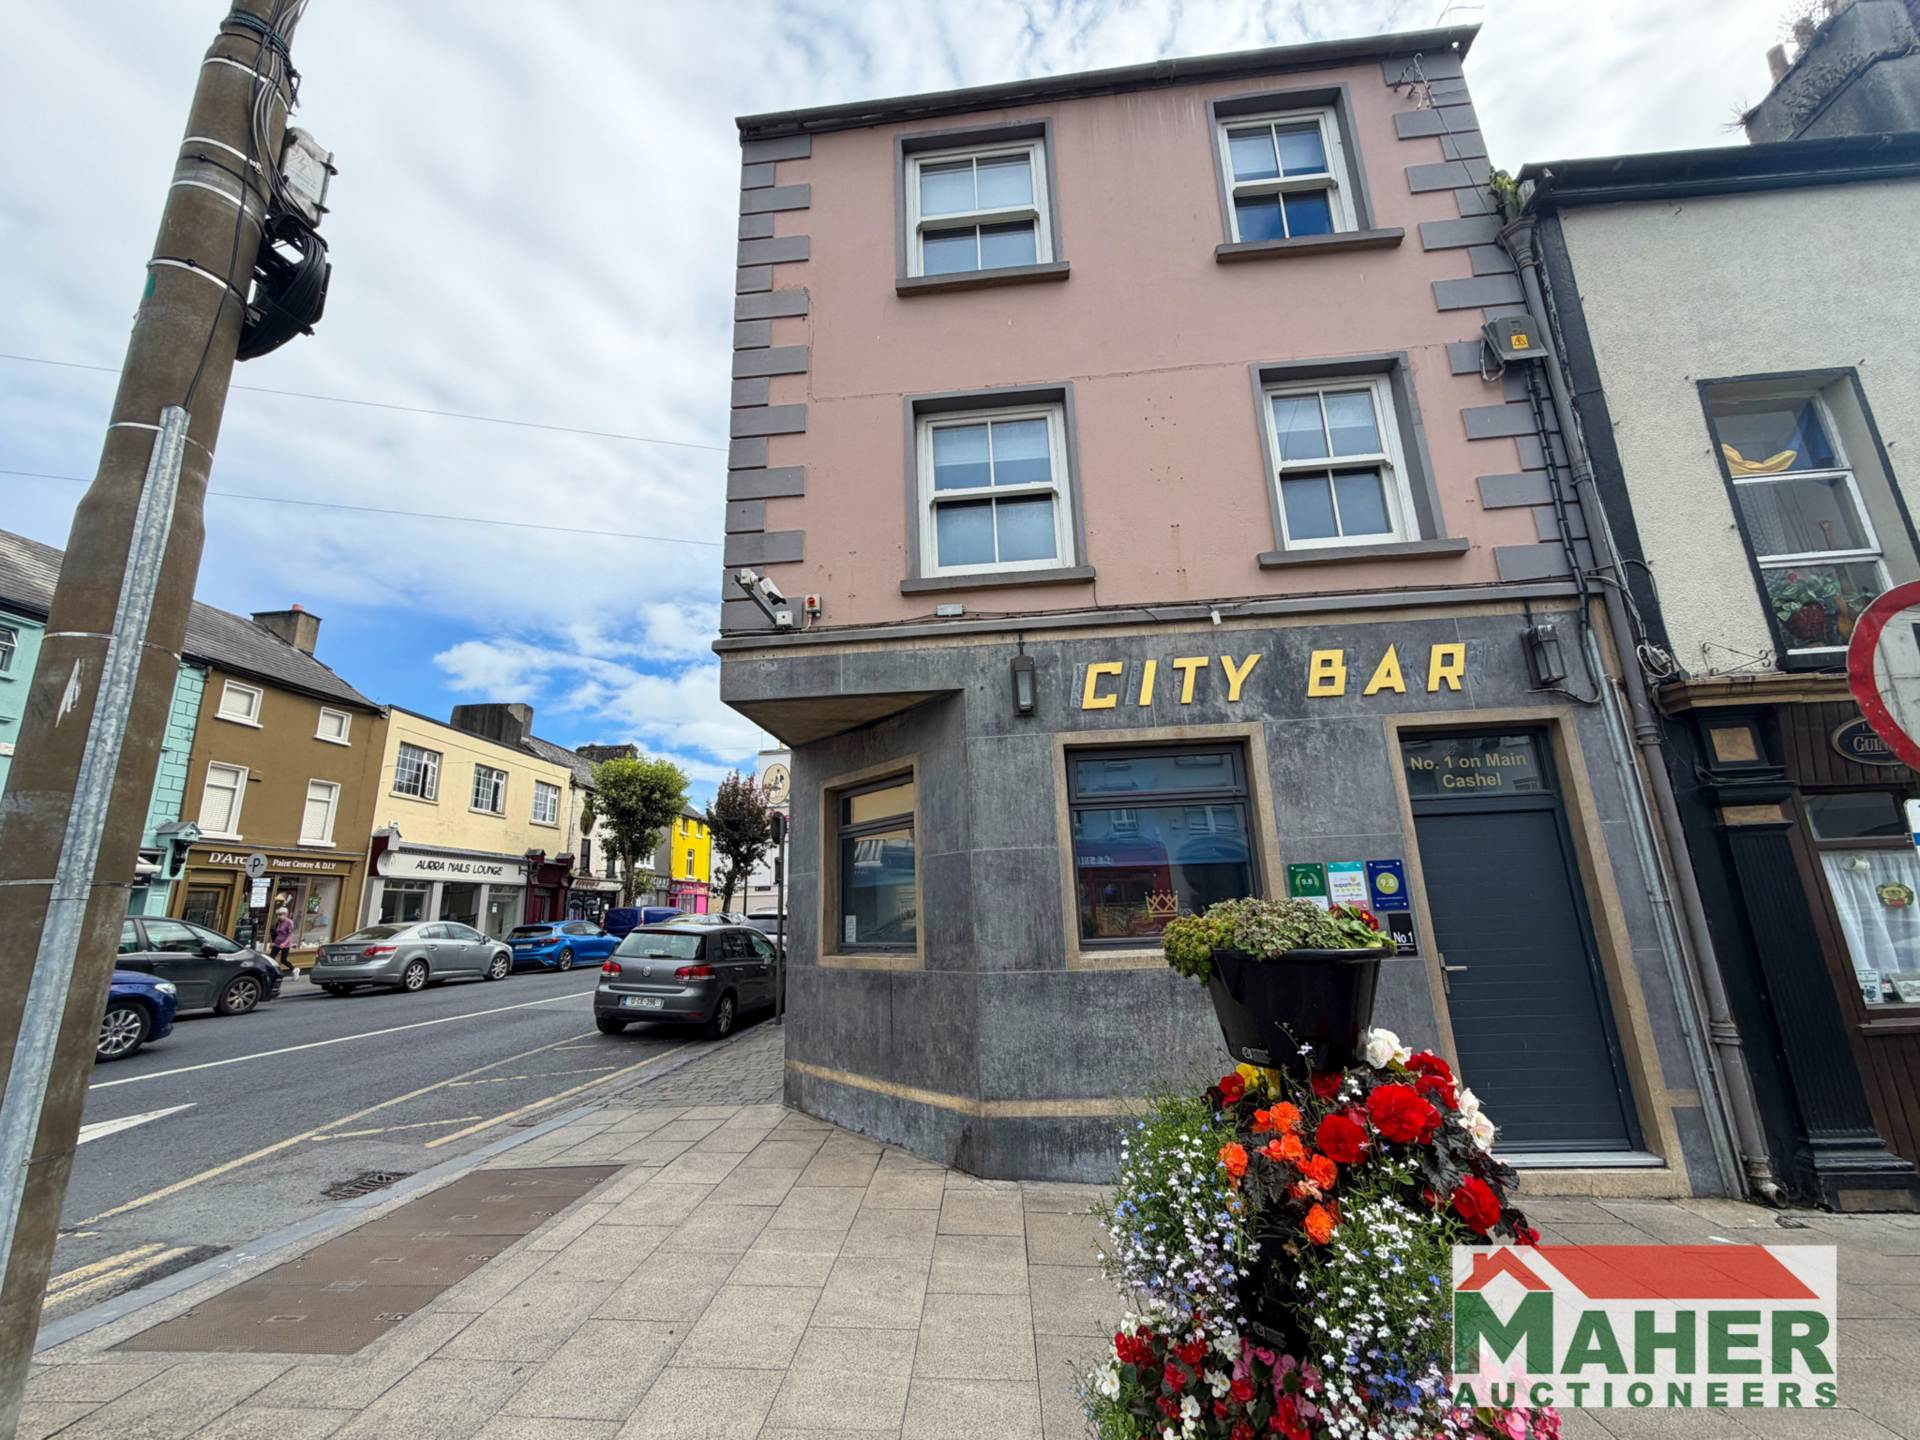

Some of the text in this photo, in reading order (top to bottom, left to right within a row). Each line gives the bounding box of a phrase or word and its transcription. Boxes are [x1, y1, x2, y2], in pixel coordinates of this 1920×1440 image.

[1082, 642, 1466, 710] CITY BAR
[1410, 752, 1527, 770] No. 1 on Main
[1442, 772, 1503, 788] Cashel
[272, 858, 291, 868] Paint
[292, 860, 314, 869] Centre
[315, 861, 321, 869] &
[447, 862, 471, 873] NAILS
[473, 865, 504, 876] LOUNGE
[1393, 931, 1414, 943] No 1
